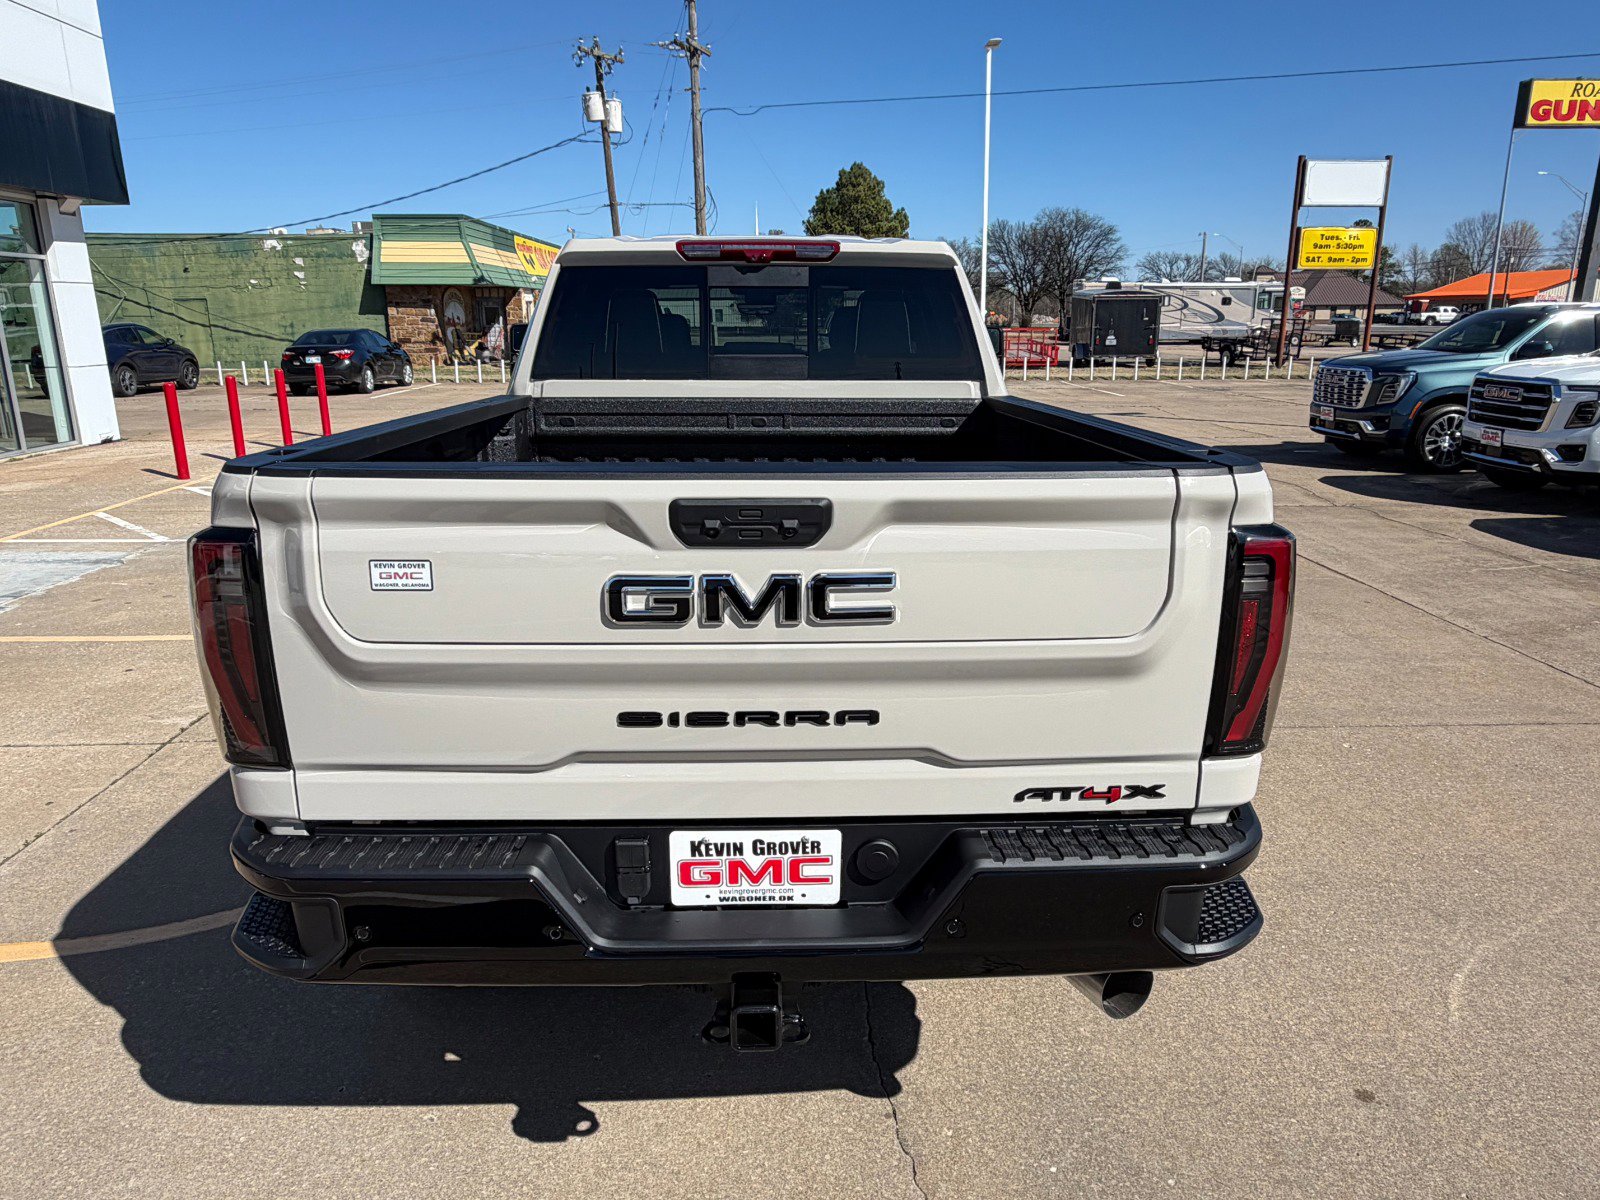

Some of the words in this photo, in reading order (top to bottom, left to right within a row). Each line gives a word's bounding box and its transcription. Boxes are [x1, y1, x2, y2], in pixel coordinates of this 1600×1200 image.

[1531, 99, 1600, 121] GUN
[1484, 386, 1519, 399] GMC
[1482, 433, 1501, 442] GMC
[602, 571, 897, 627] GMC
[616, 710, 881, 728] SIERRA
[1013, 784, 1166, 804] AT4X
[677, 855, 834, 889] GMC
[719, 887, 794, 895] kevingrovergmc.com
